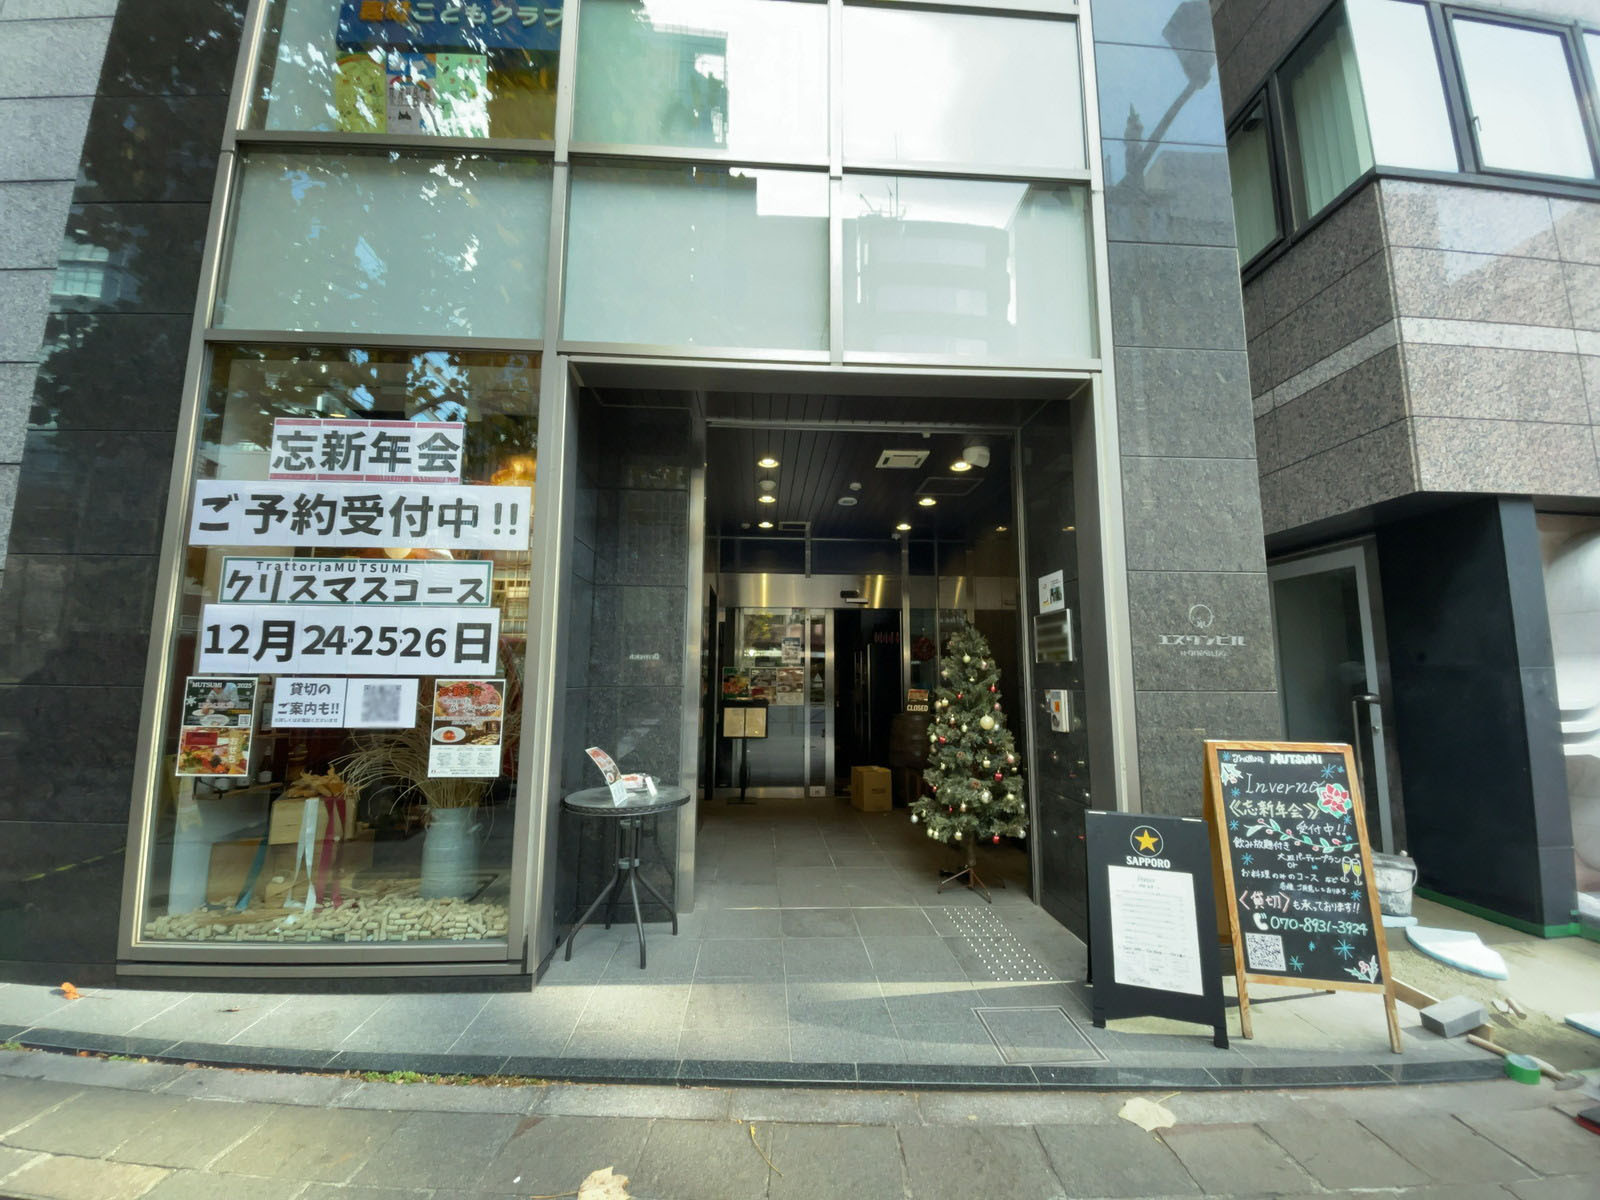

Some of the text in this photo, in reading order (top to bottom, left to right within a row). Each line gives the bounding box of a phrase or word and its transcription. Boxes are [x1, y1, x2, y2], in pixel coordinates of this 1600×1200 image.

[272, 430, 461, 473] 忘新年会
[198, 493, 519, 538] ご予約受付中!!
[256, 561, 409, 573] TrattoriaMUTSUMI
[226, 569, 485, 603] クリスマスコース
[290, 682, 331, 695] 貸切の
[277, 702, 340, 715] ご案内も!!
[906, 704, 929, 712] CLOSED
[1269, 753, 1323, 765] MUTSUMI
[1245, 772, 1326, 795] Inverno
[1233, 836, 1291, 851] 飲み放題付き
[1126, 855, 1171, 869] SAPPORO
[1241, 868, 1320, 883] お料理のみのコース
[1270, 915, 1369, 937] 070-8931-3924
